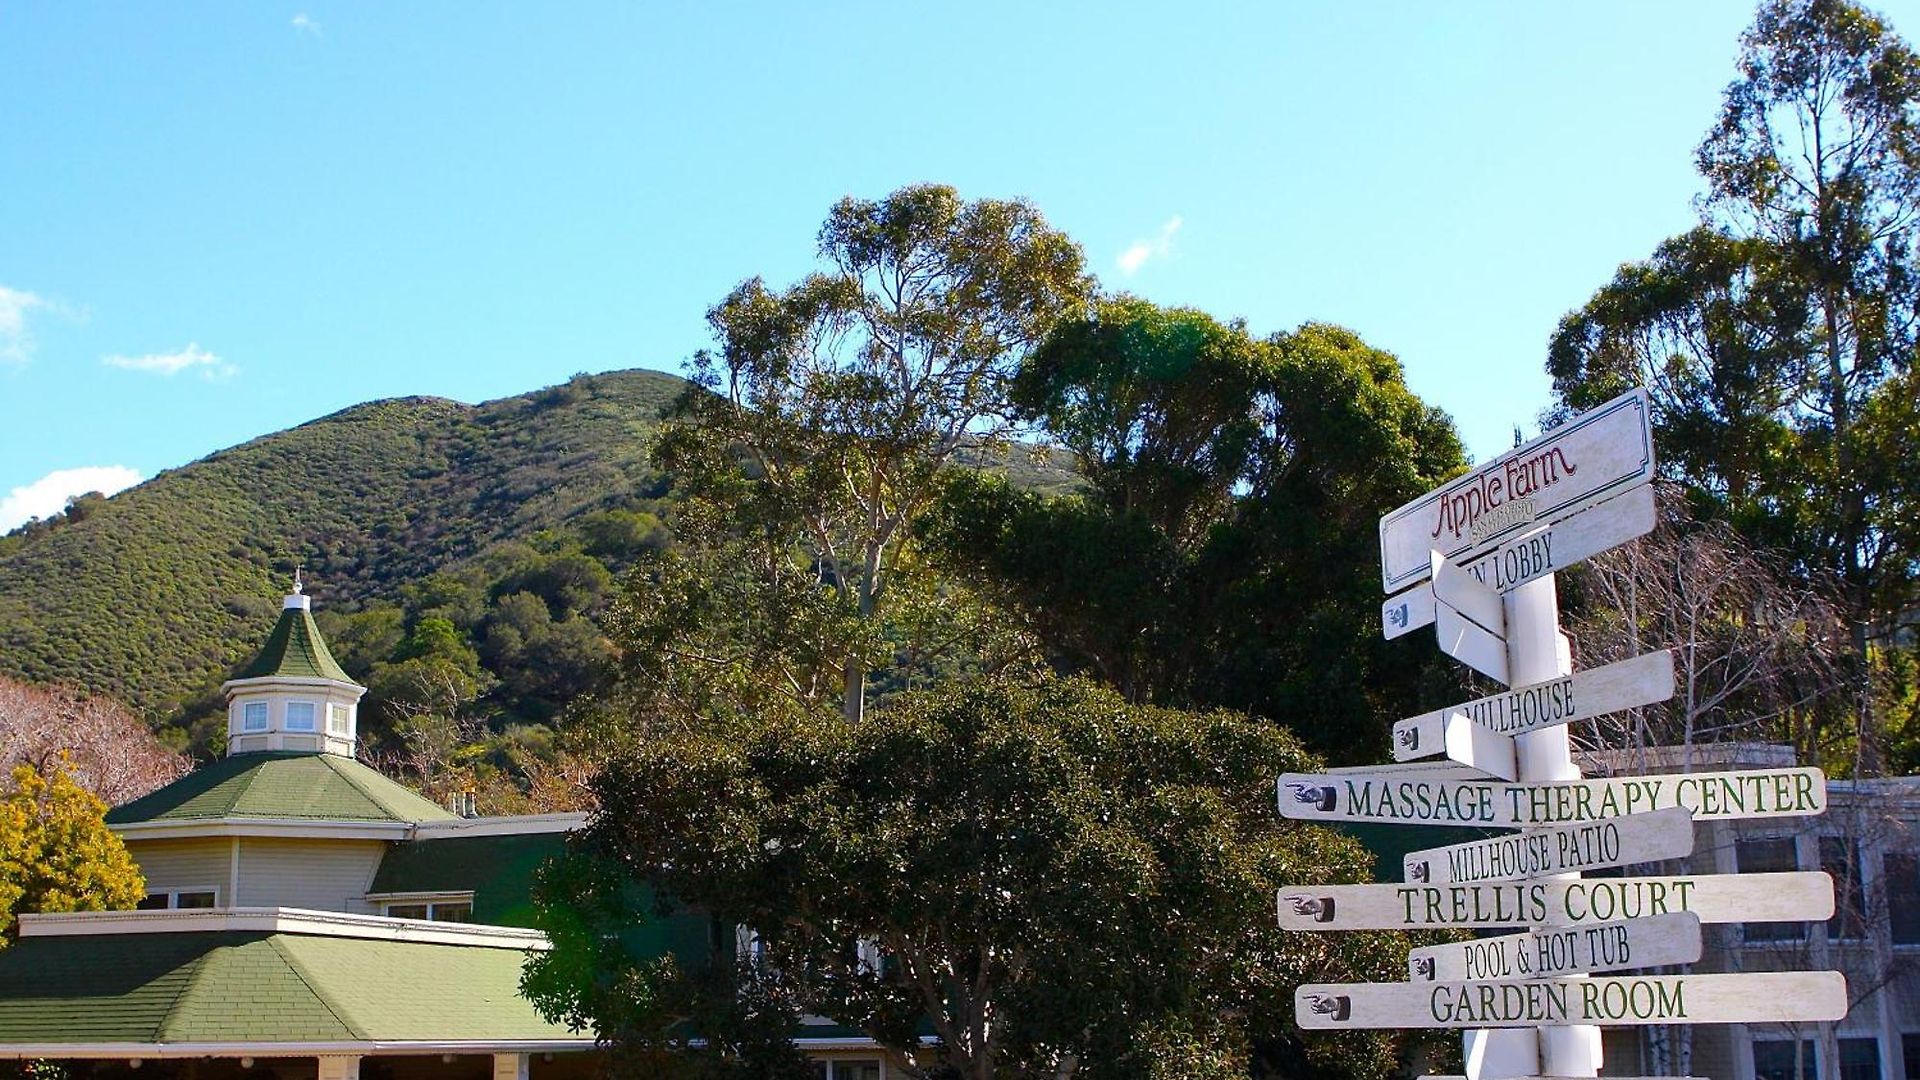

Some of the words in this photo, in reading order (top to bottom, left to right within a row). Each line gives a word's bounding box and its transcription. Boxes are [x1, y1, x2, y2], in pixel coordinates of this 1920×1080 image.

[1432, 474, 1502, 538] Apple
[1504, 447, 1577, 501] Farm
[1494, 533, 1553, 590] LOBBY
[1345, 780, 1495, 821] MASSAGE
[1505, 781, 1663, 822] THERAPY
[1676, 773, 1818, 816] CENTER
[1448, 834, 1551, 883] MILLHOUSE
[1557, 823, 1620, 869] PATIO
[1397, 884, 1546, 923] TRELLIS
[1564, 881, 1695, 922] COURT
[1464, 941, 1511, 979] POOL
[1517, 938, 1532, 974] &
[1536, 932, 1578, 971] HOT
[1586, 925, 1630, 966] TUB
[1431, 983, 1568, 1023] GARDEN
[1580, 980, 1688, 1020] ROOM
